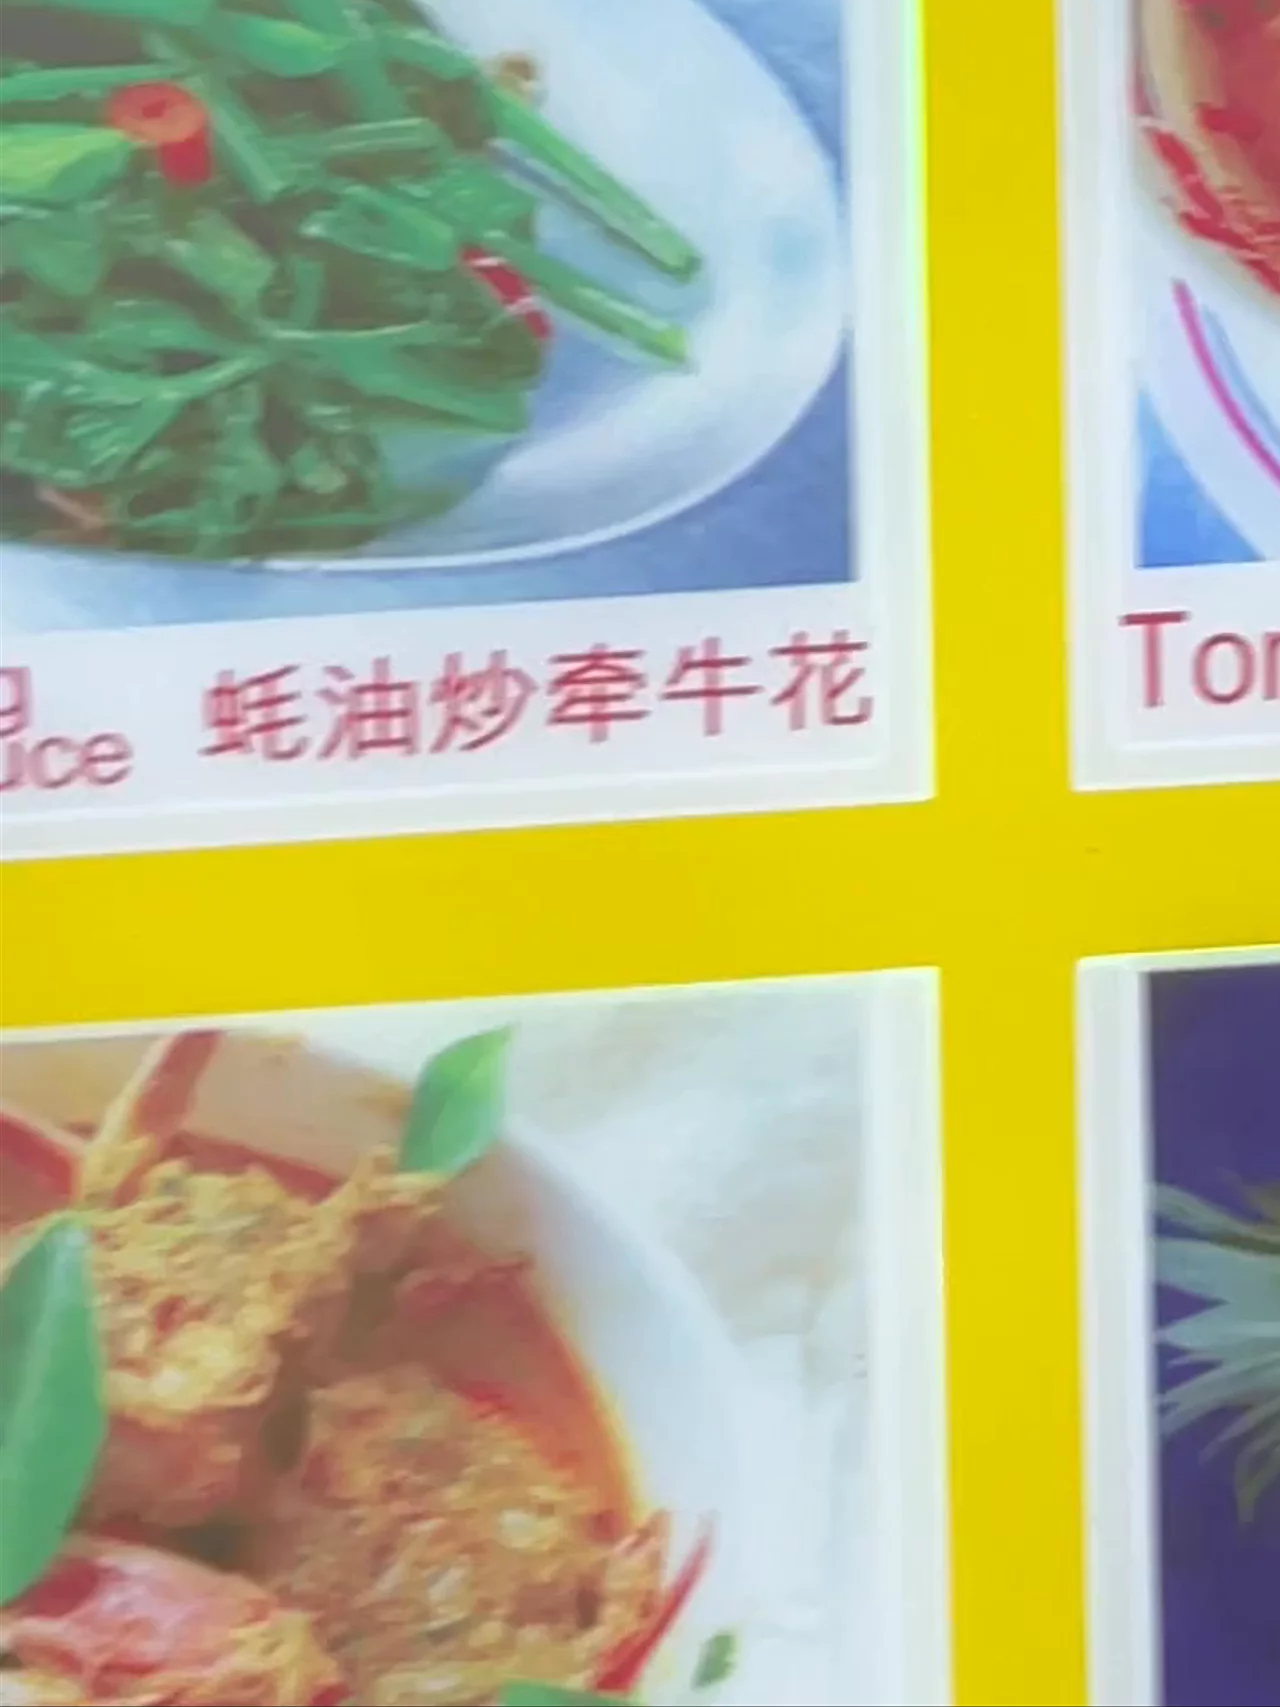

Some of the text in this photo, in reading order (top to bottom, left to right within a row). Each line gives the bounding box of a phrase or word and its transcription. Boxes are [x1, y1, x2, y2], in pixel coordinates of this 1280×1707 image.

[200, 630, 873, 762] 蚝油炒牵牛花
